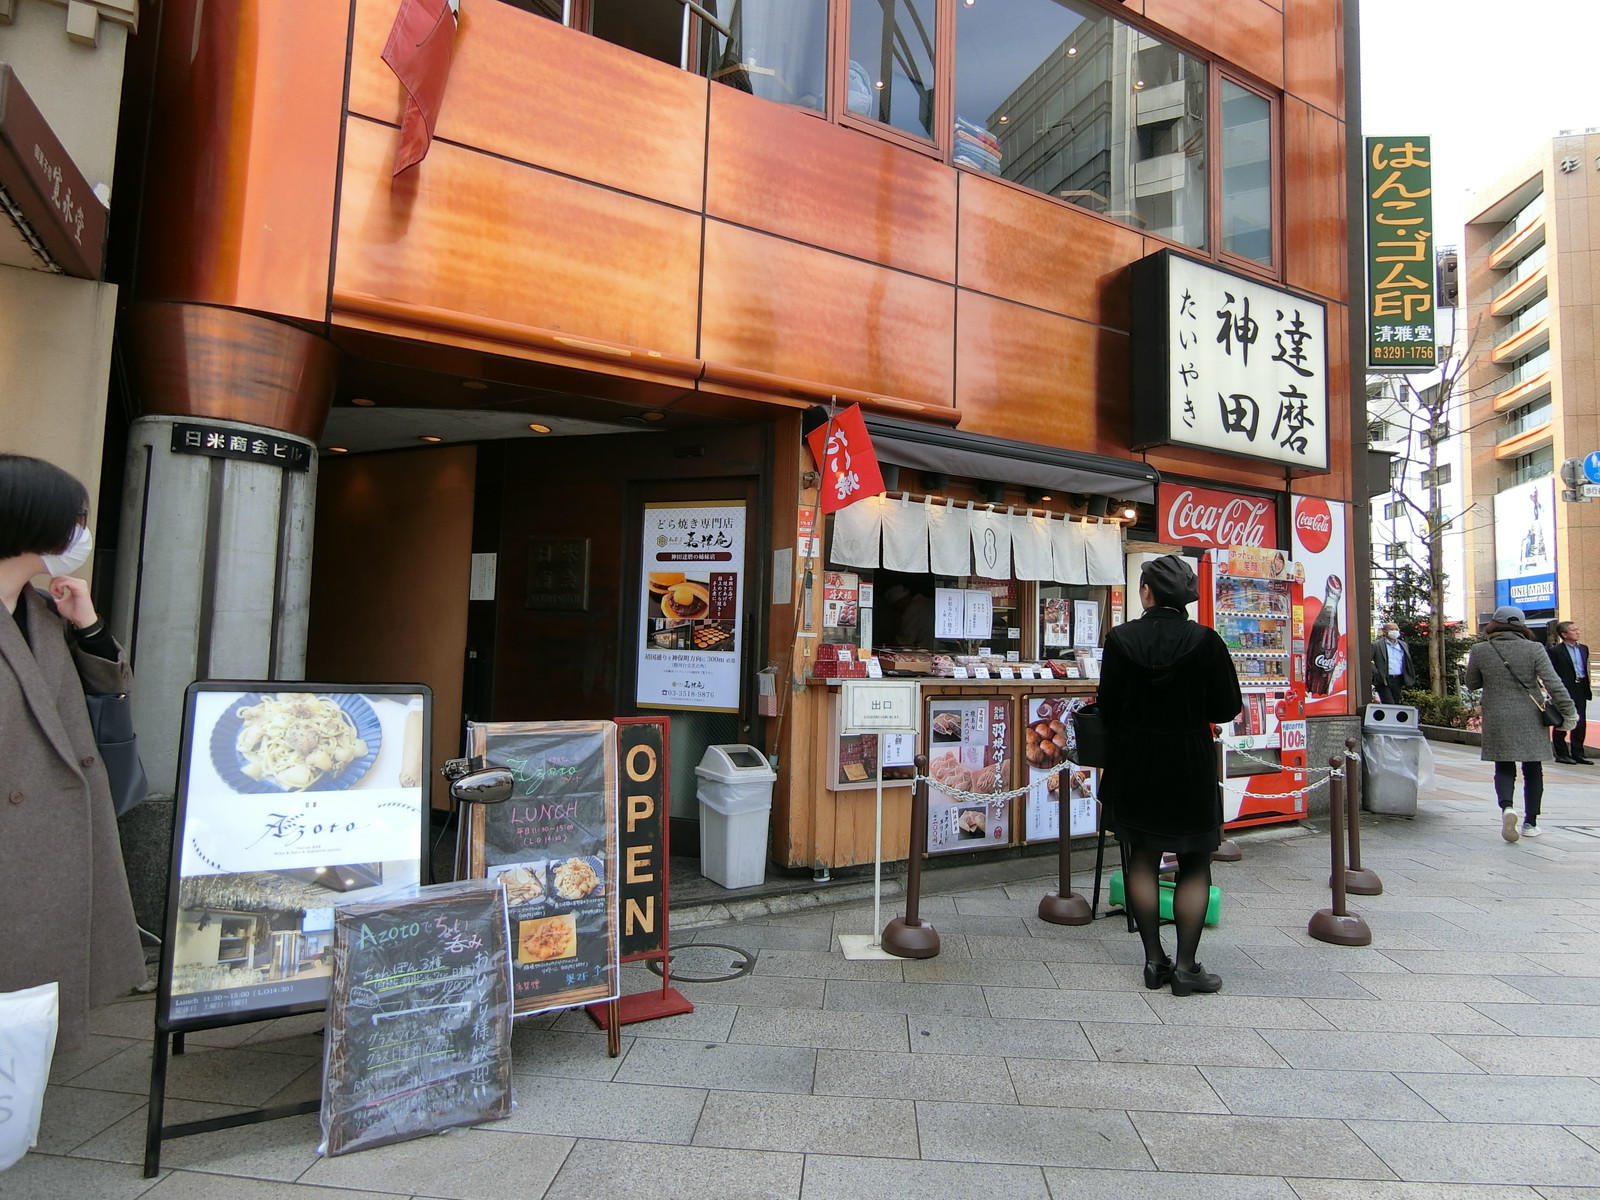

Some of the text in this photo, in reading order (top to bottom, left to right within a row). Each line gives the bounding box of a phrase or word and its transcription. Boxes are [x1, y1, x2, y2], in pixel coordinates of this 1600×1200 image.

[1371, 141, 1432, 322] はんこ・ゴム印
[1374, 325, 1433, 342] 清雅堂
[1178, 287, 1200, 428] たいやき
[1216, 290, 1260, 443] 神田
[1382, 347, 1434, 359] 3291-1756
[1271, 308, 1315, 455] 達磨
[185, 430, 303, 461] 日米商会ビル
[657, 518, 734, 530] どら焼き専門店
[1167, 490, 1269, 548] Coca-Cola
[1296, 511, 1331, 533] Coca-Cola
[871, 700, 893, 710] 出口
[1283, 731, 1300, 748] 100
[505, 757, 588, 795] Azoto
[511, 800, 578, 825] LUNCH
[245, 813, 370, 850] Azoto
[625, 743, 657, 936] OPEN
[444, 933, 483, 953] 呑み
[175, 997, 199, 1006] Lunch
